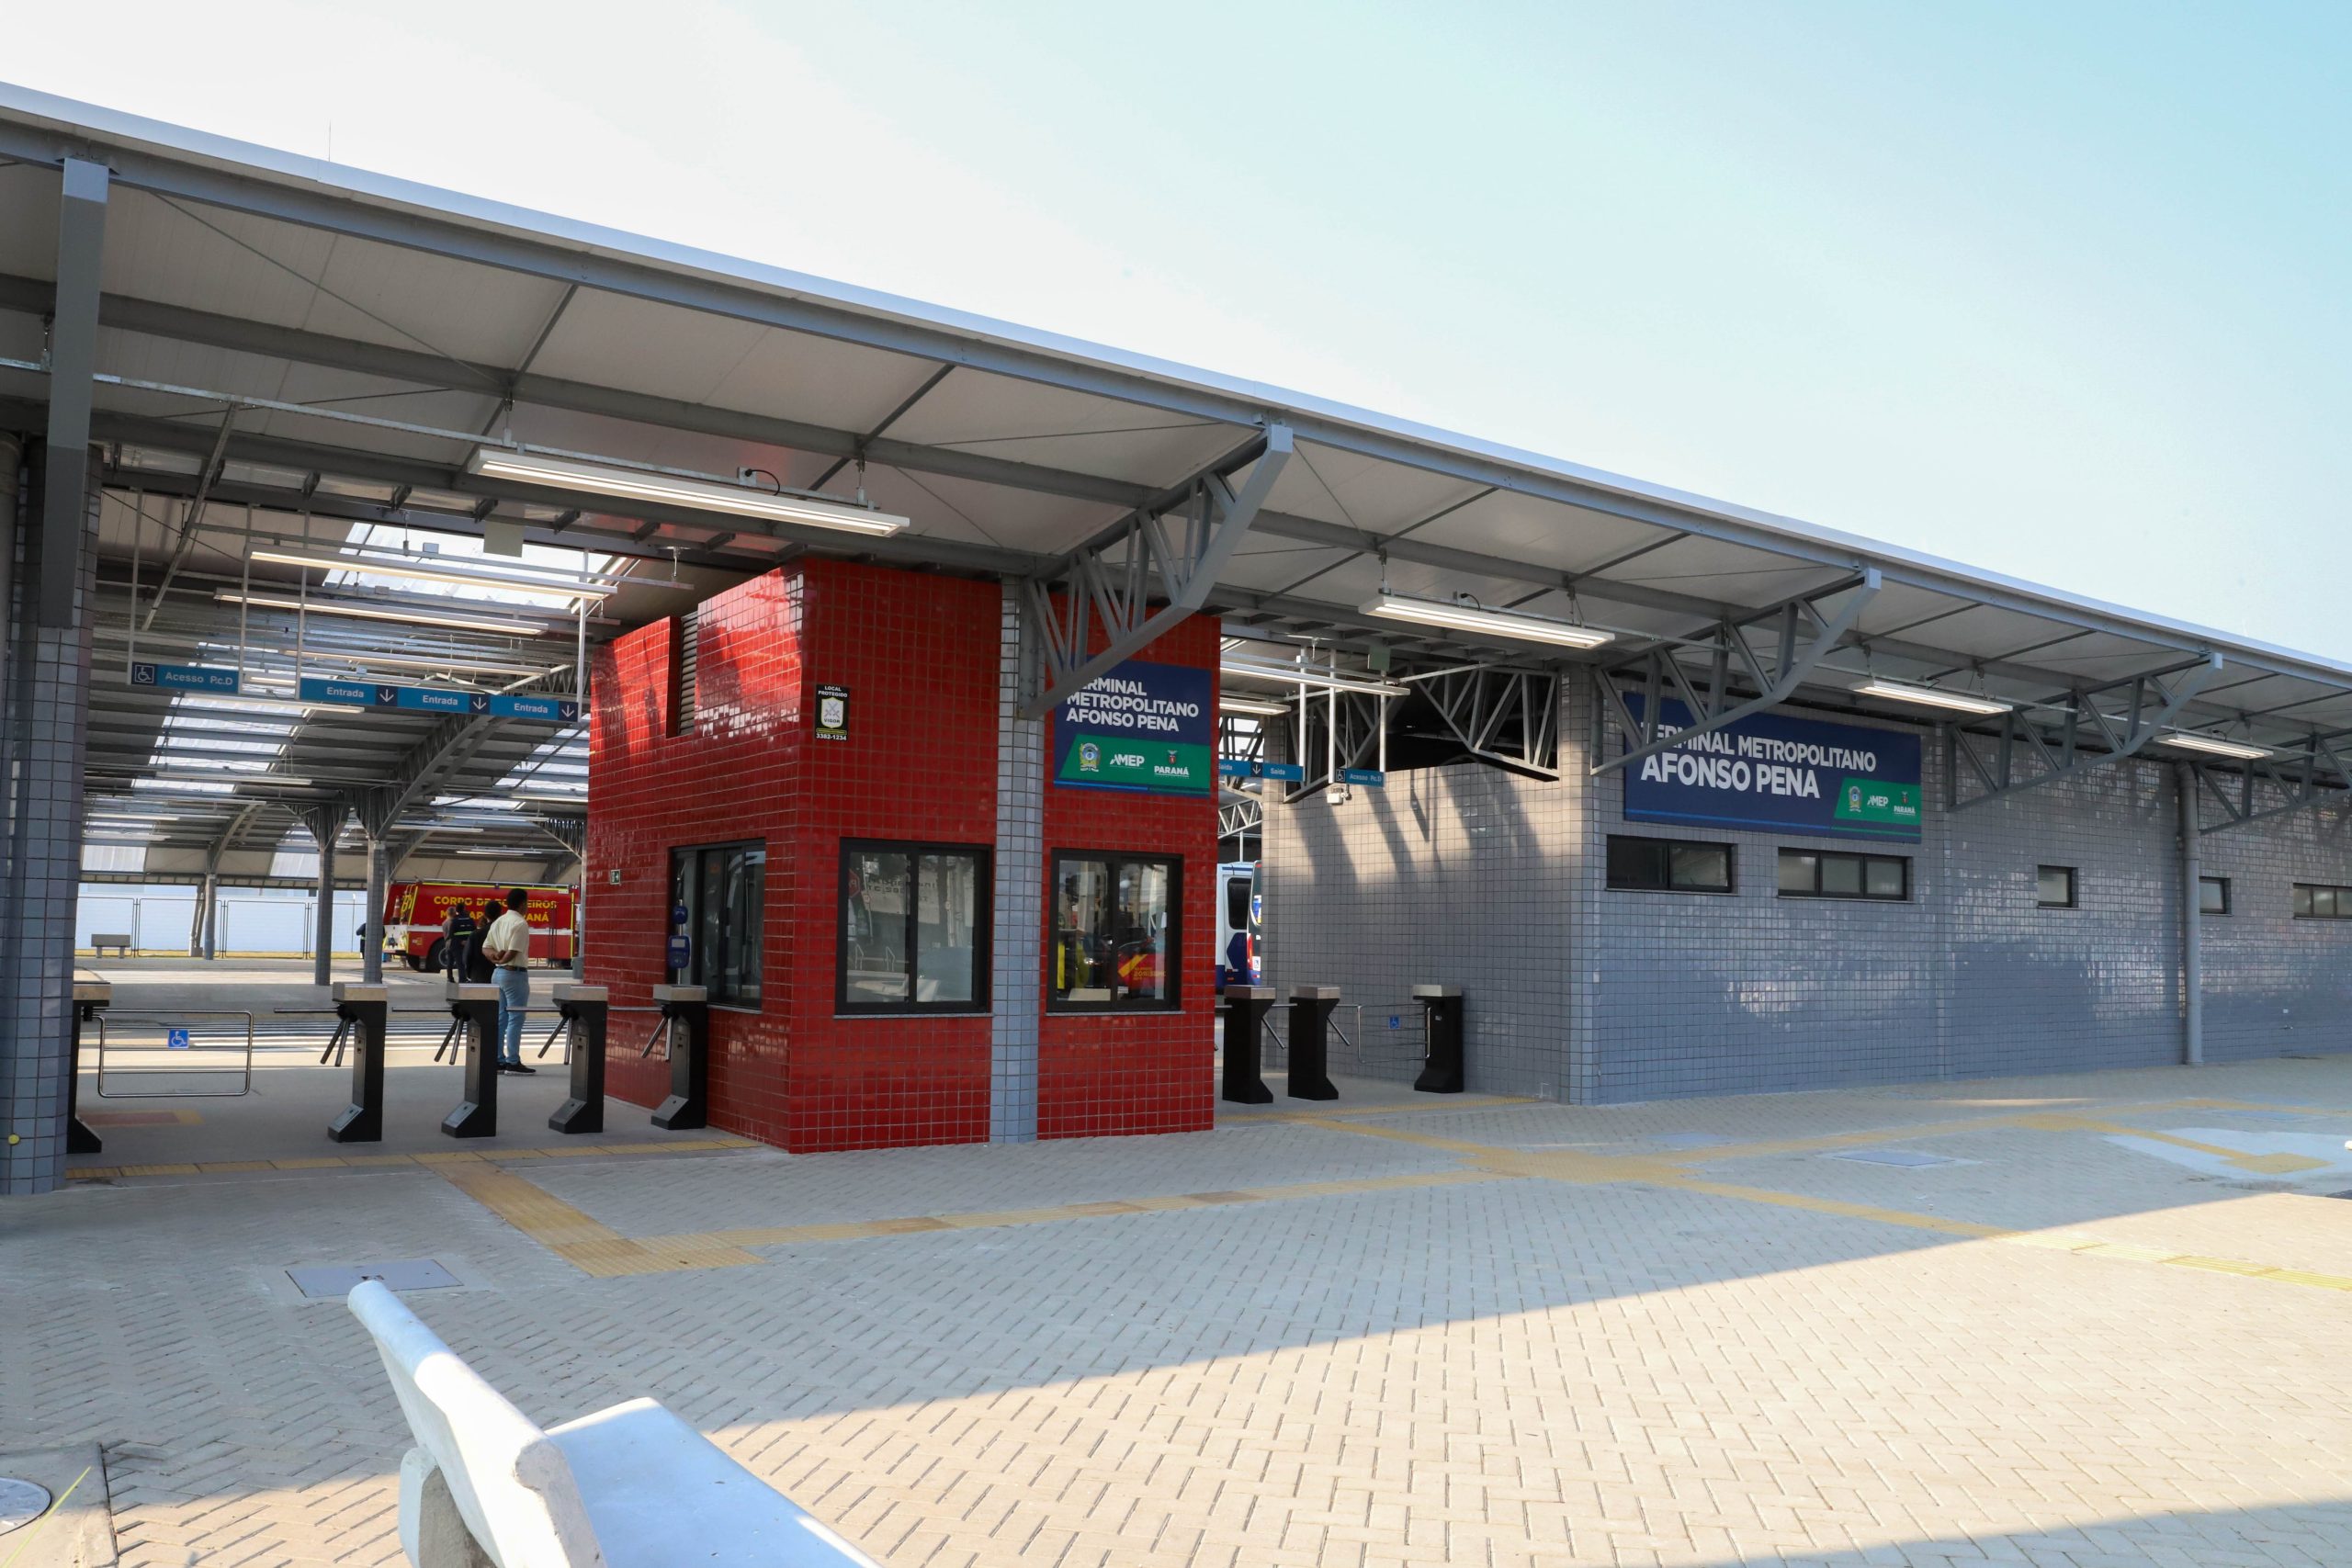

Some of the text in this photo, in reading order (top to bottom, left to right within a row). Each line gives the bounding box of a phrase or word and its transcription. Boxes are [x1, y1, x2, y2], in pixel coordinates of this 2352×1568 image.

[164, 671, 204, 683] Acesso
[326, 686, 365, 698] Entrada
[1081, 677, 1148, 696] RMINAL
[422, 694, 458, 706] Entrada
[1067, 692, 1200, 718] METROPOLITANO
[514, 703, 548, 715] Entrada
[1066, 707, 1180, 732] AFONSO PENA
[1640, 721, 1877, 773] ERINAL METROPOLITANO
[1109, 753, 1145, 767] AMEP
[1154, 765, 1189, 775] PARANÁ
[1640, 751, 1821, 799] AFONSO PENA
[1867, 795, 1889, 807] AMEP
